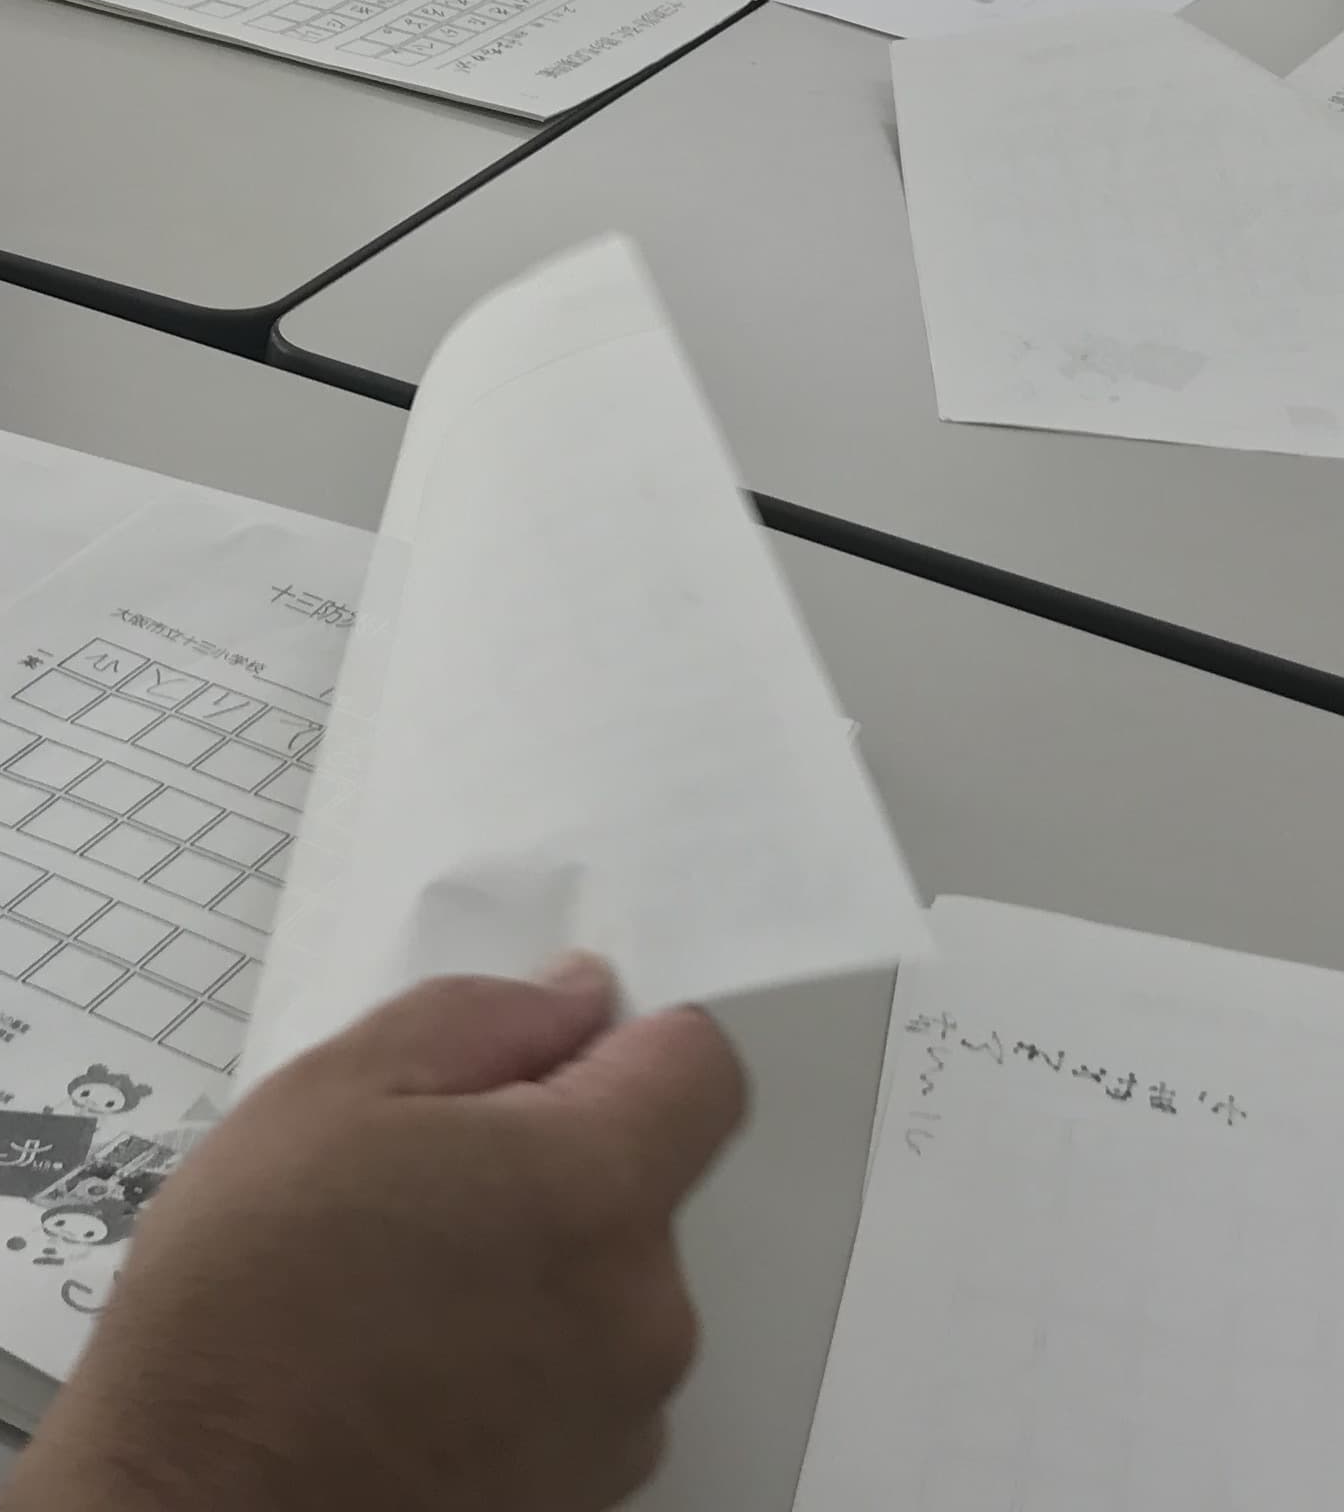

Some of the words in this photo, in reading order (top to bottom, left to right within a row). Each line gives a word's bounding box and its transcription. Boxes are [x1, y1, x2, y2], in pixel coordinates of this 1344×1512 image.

[270, 583, 359, 629] 十三防
[108, 607, 267, 675] 大阪市立十三小学校
